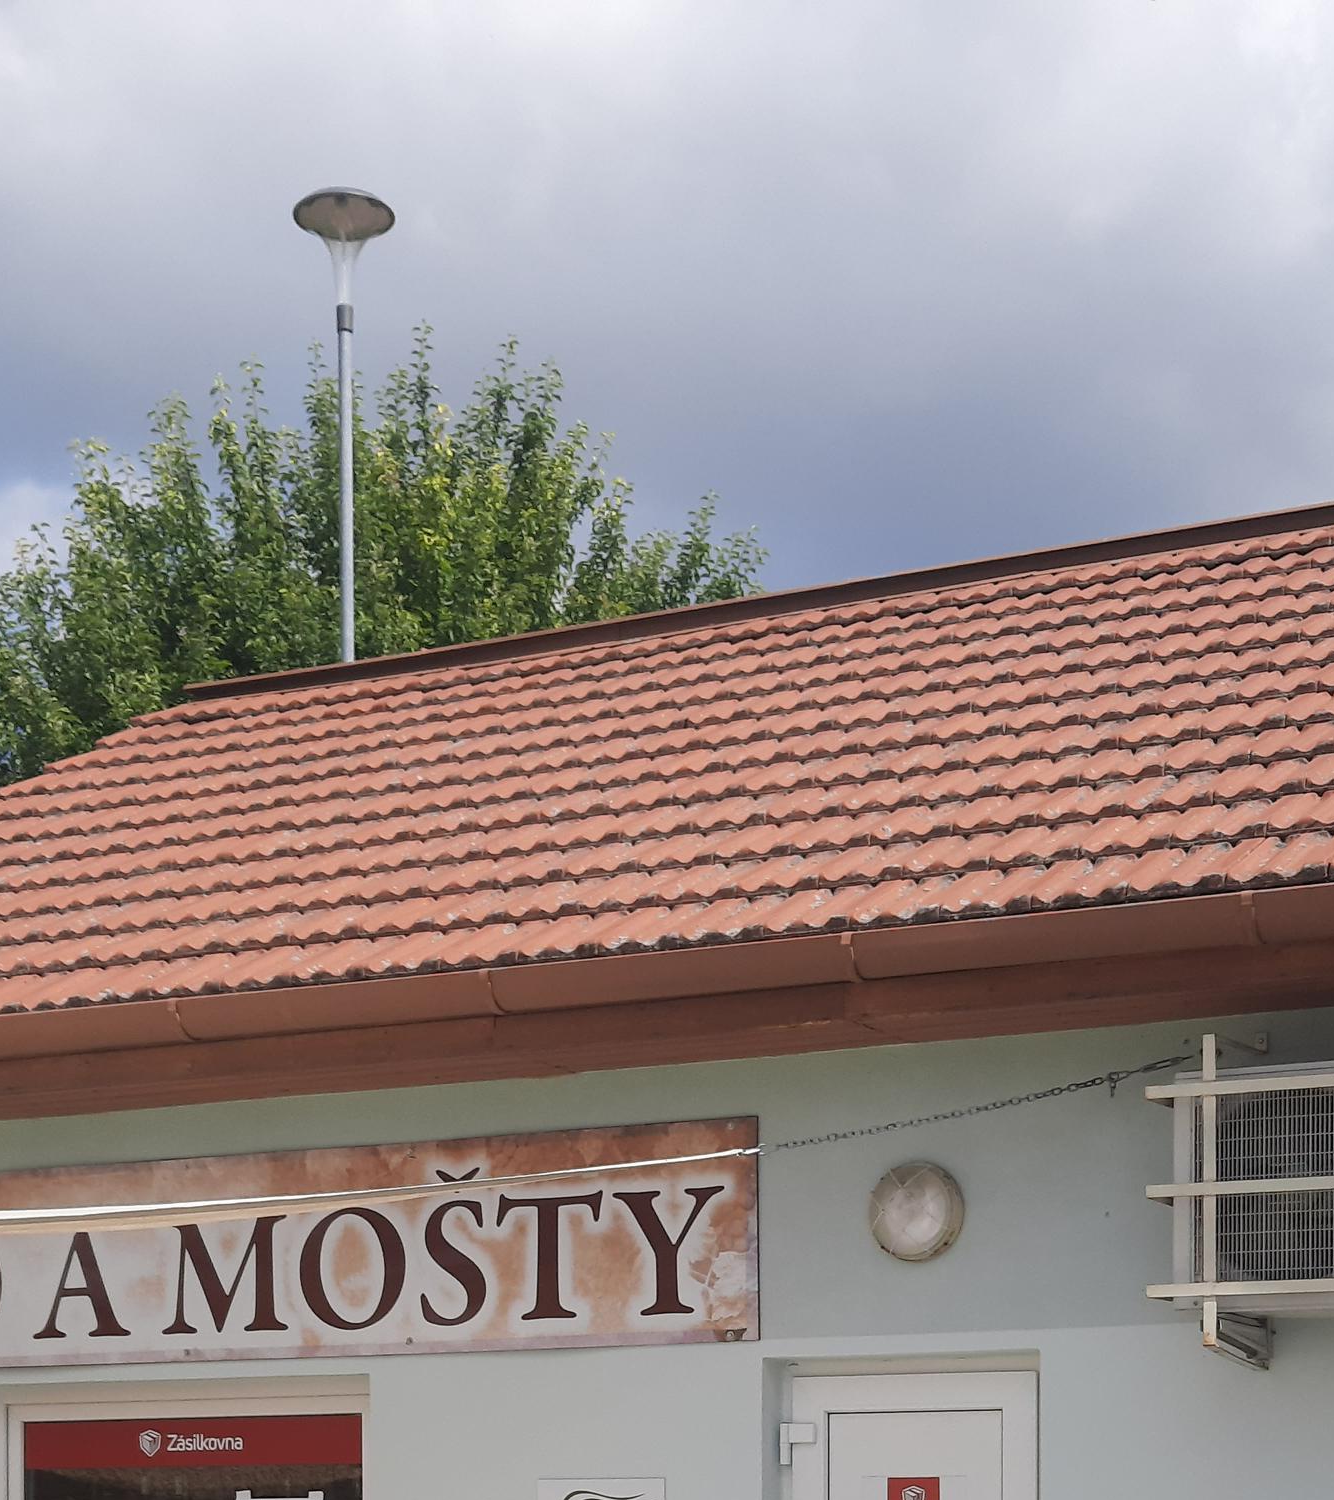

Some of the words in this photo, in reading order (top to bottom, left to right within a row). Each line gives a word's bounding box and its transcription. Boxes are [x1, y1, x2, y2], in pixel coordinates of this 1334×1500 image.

[33, 1231, 132, 1340] A
[161, 1167, 726, 1335] MOŠTY
[167, 1433, 244, 1452] Zásilkovna
